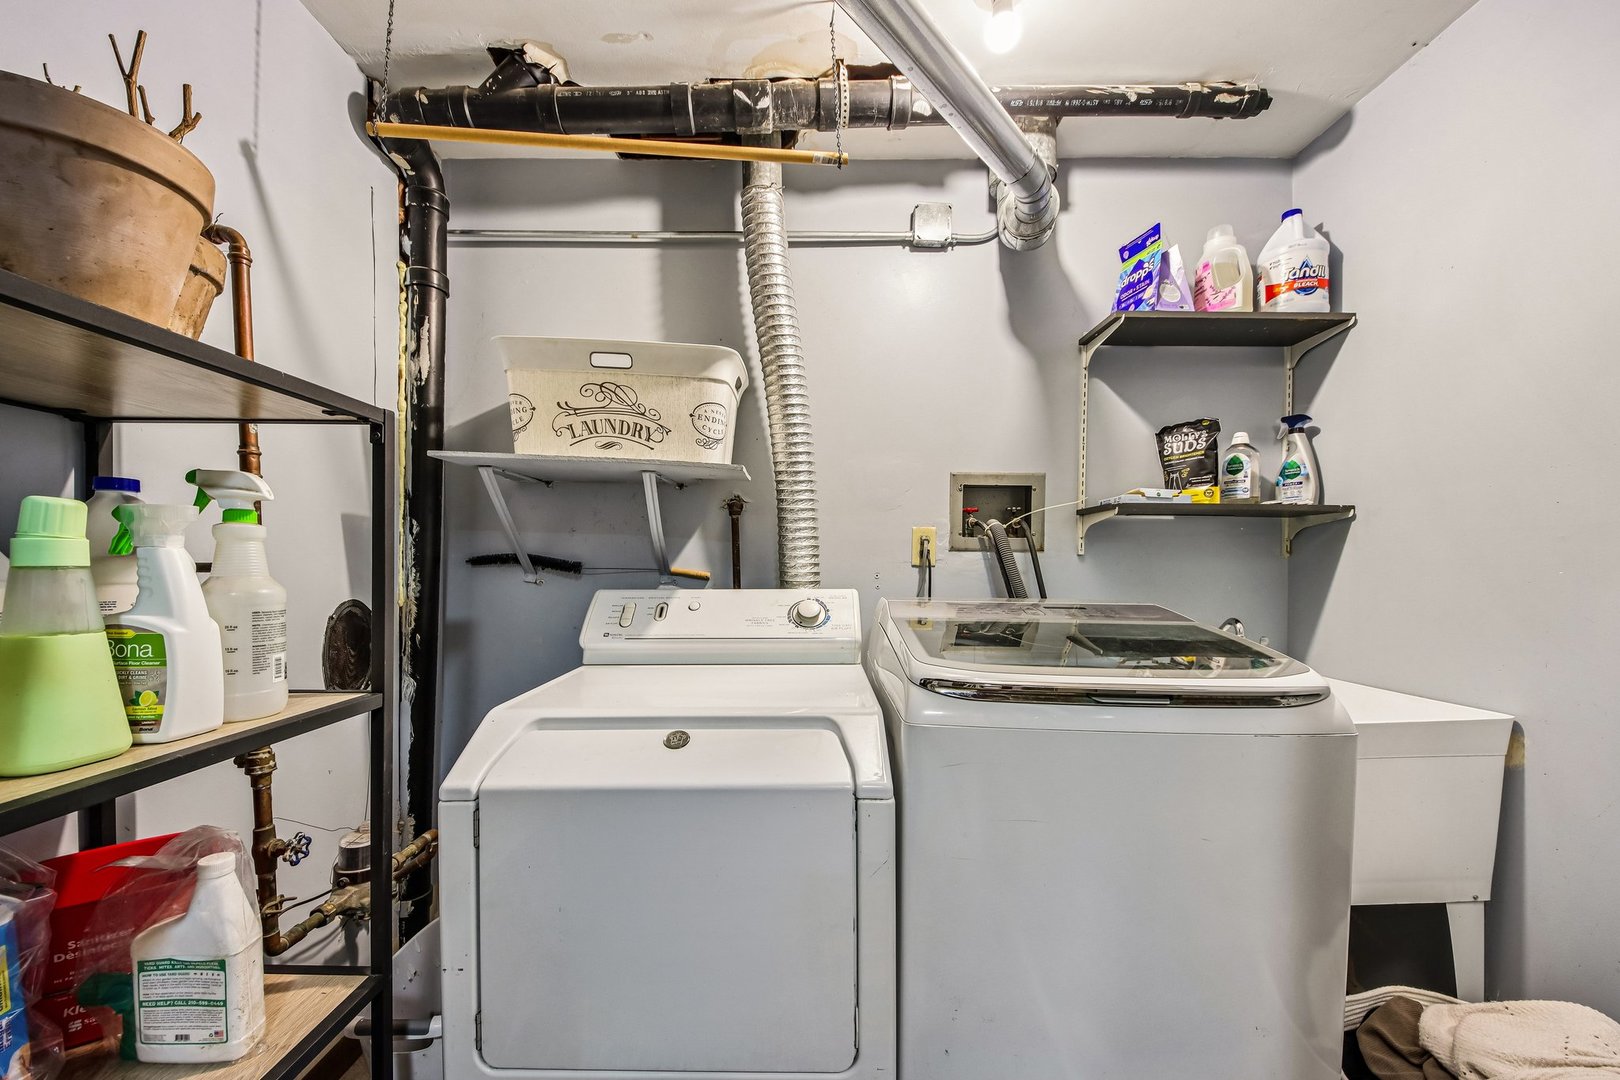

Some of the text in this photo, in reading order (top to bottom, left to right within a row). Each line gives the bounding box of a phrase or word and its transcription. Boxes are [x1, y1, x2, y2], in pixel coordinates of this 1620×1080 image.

[1284, 263, 1326, 282] Tandil
[567, 418, 664, 443] LAUNDRY
[1163, 430, 1208, 443] MOLLY'S
[1163, 437, 1206, 456] SUDS
